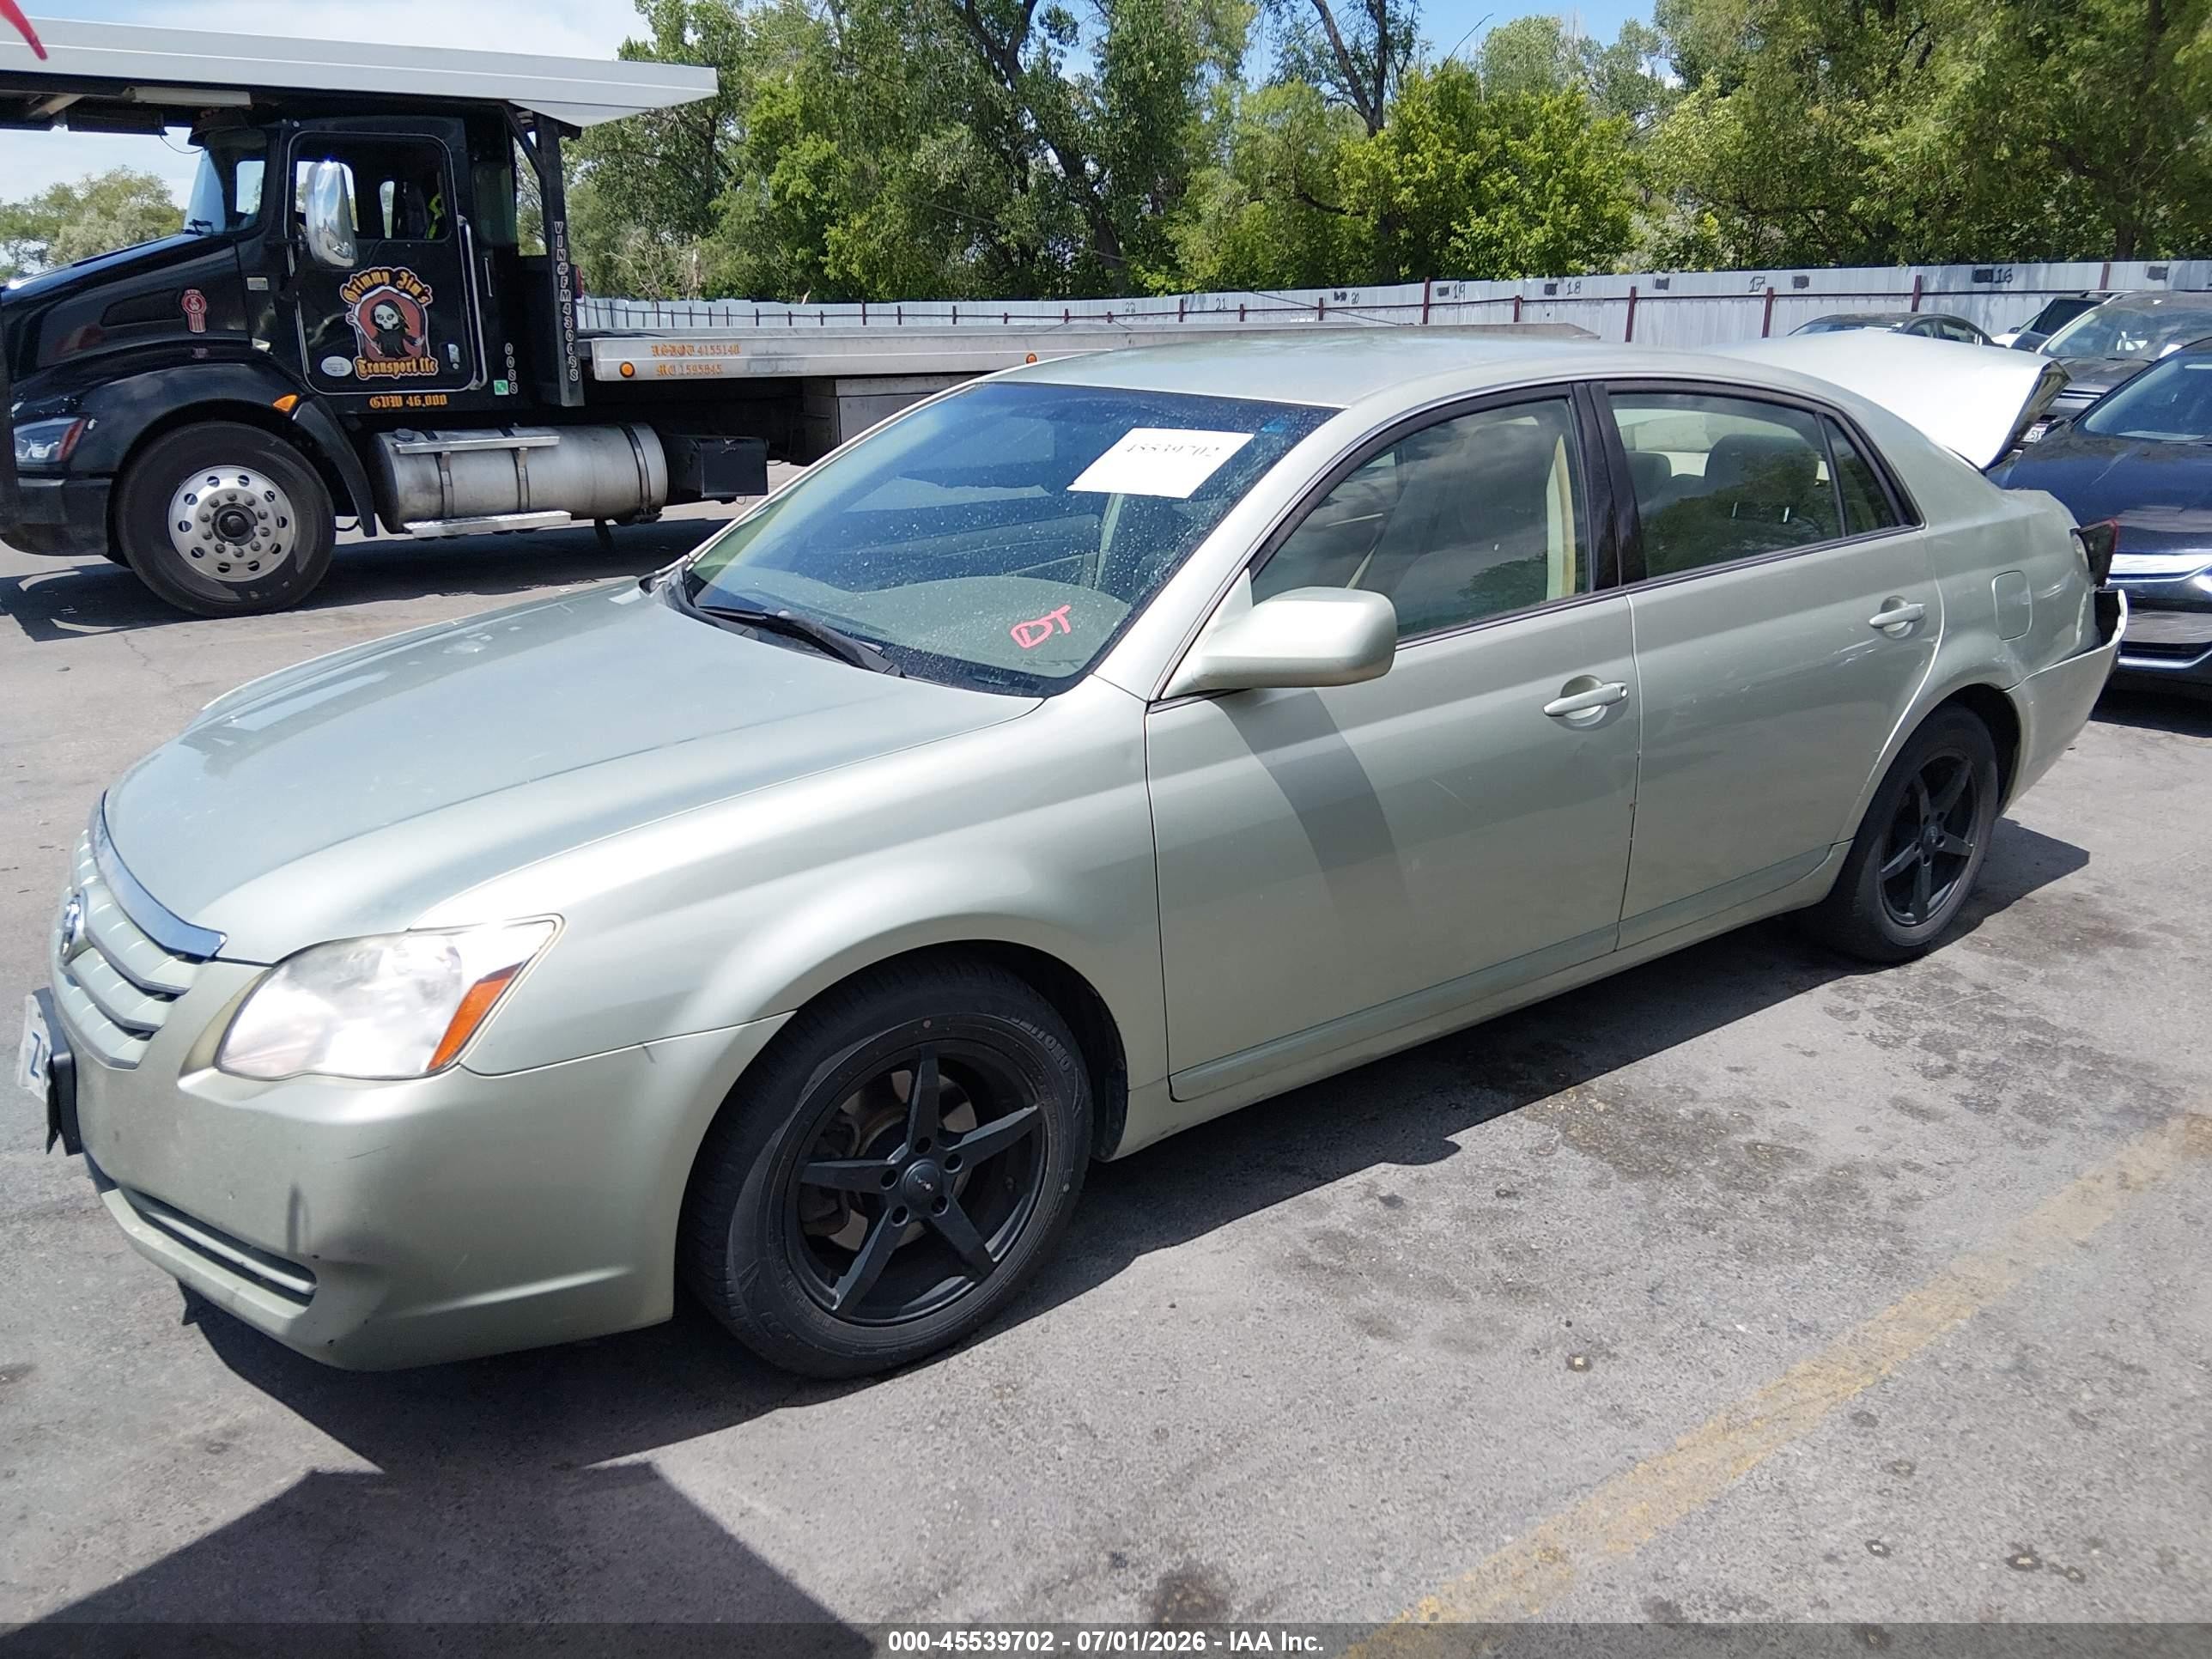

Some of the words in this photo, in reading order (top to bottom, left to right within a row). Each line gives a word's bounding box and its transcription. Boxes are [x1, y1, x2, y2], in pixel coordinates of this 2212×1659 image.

[1994, 267, 2013, 283] 16
[343, 270, 390, 303] Grimmy
[396, 270, 430, 304] Jim's
[1453, 283, 1466, 301] 19
[1566, 280, 1581, 296] 18
[1215, 298, 1228, 311] 21
[356, 357, 417, 378] Transport
[504, 342, 519, 394] 0088
[1010, 604, 1071, 648] DT
